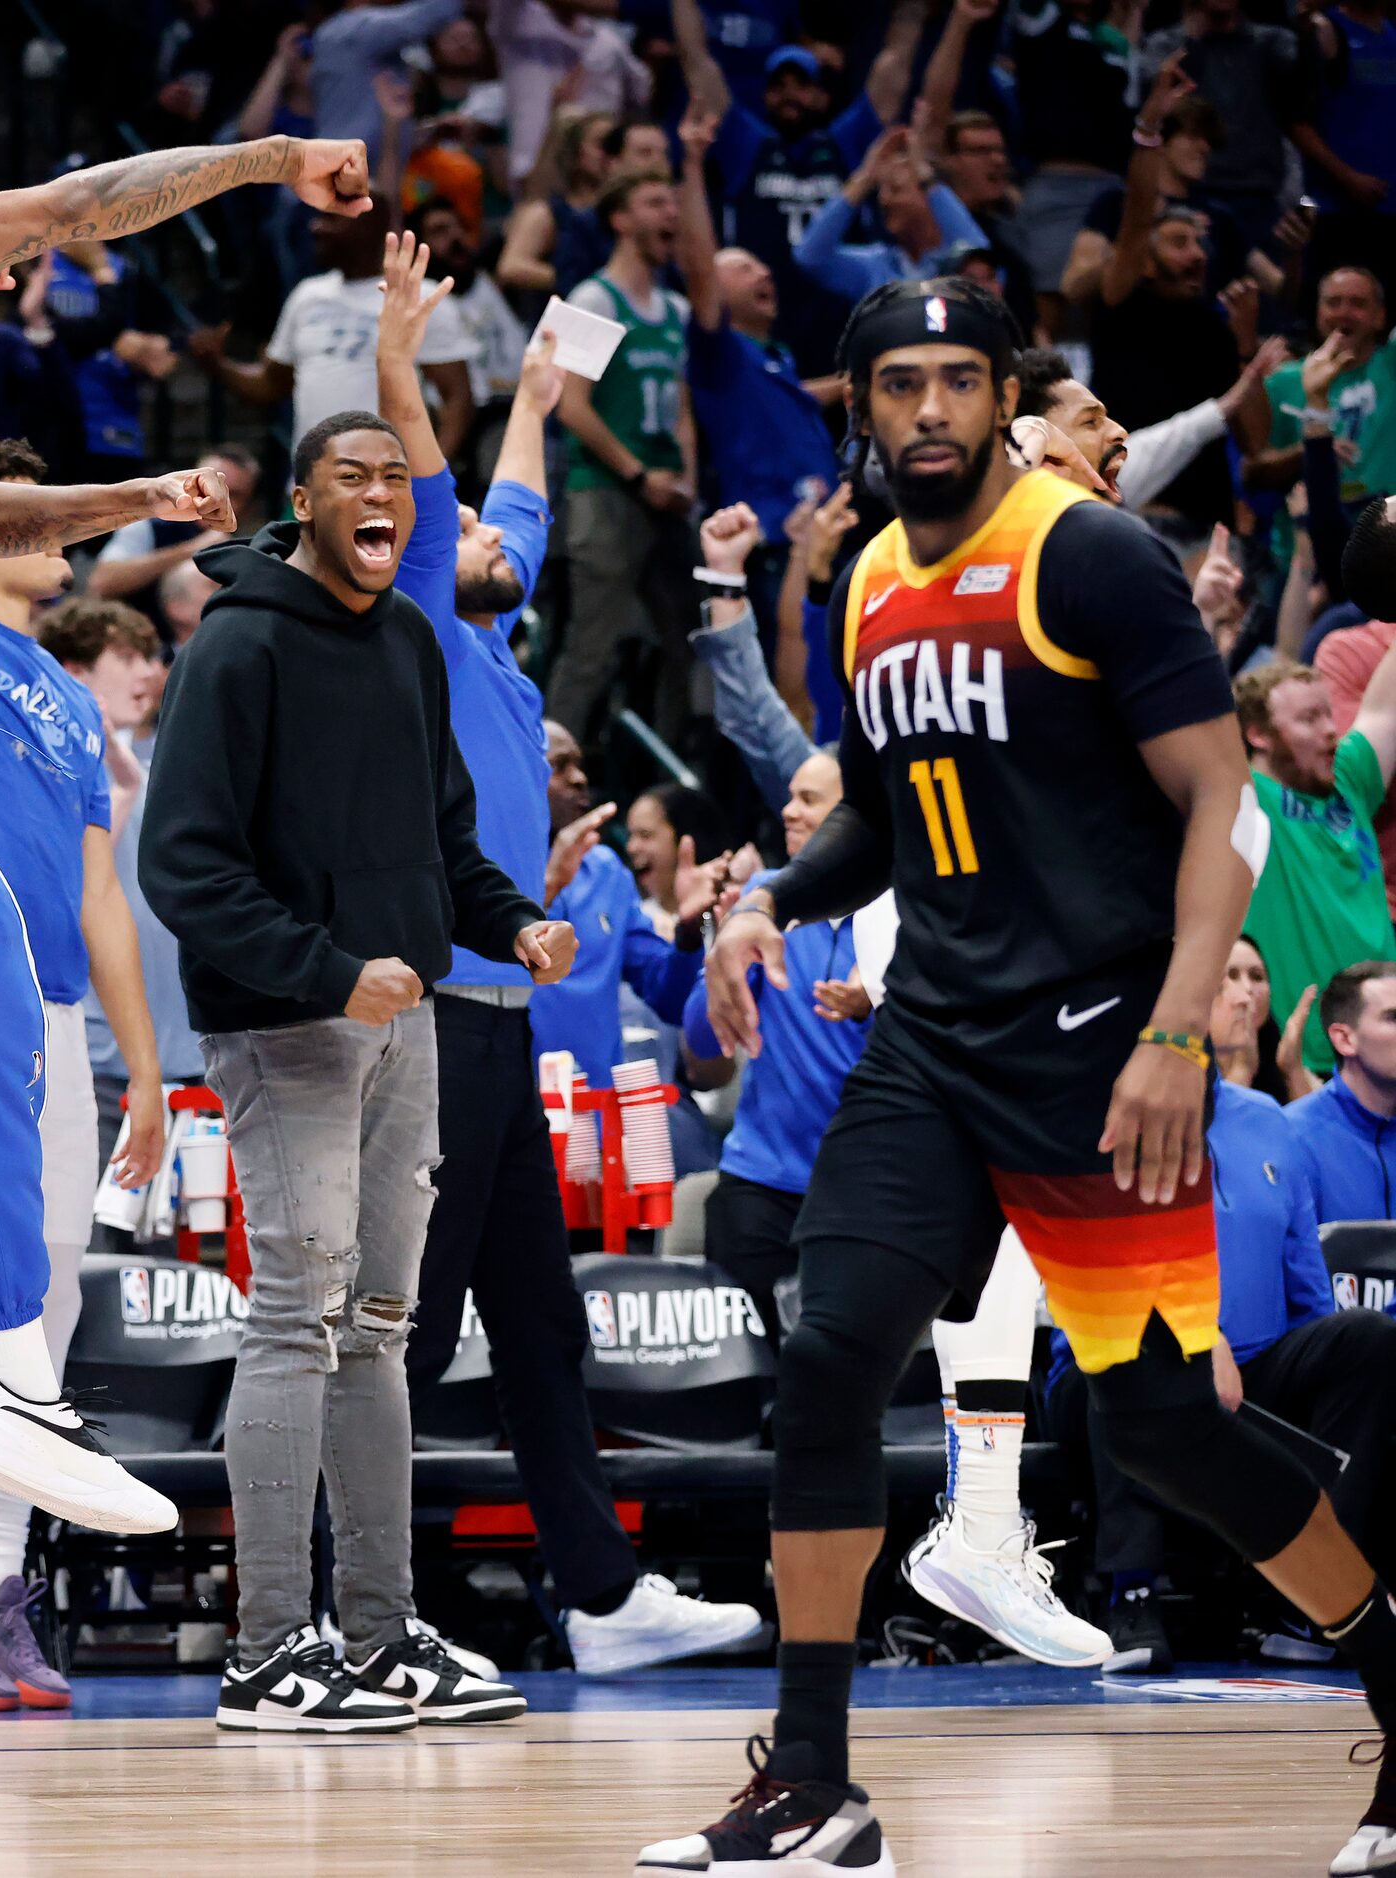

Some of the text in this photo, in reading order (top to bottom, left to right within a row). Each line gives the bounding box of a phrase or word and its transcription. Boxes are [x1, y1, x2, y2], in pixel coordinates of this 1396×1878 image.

[855, 638, 1010, 752] UTAH
[908, 756, 981, 877] 11
[617, 1286, 766, 1347] PLAYOFFS
